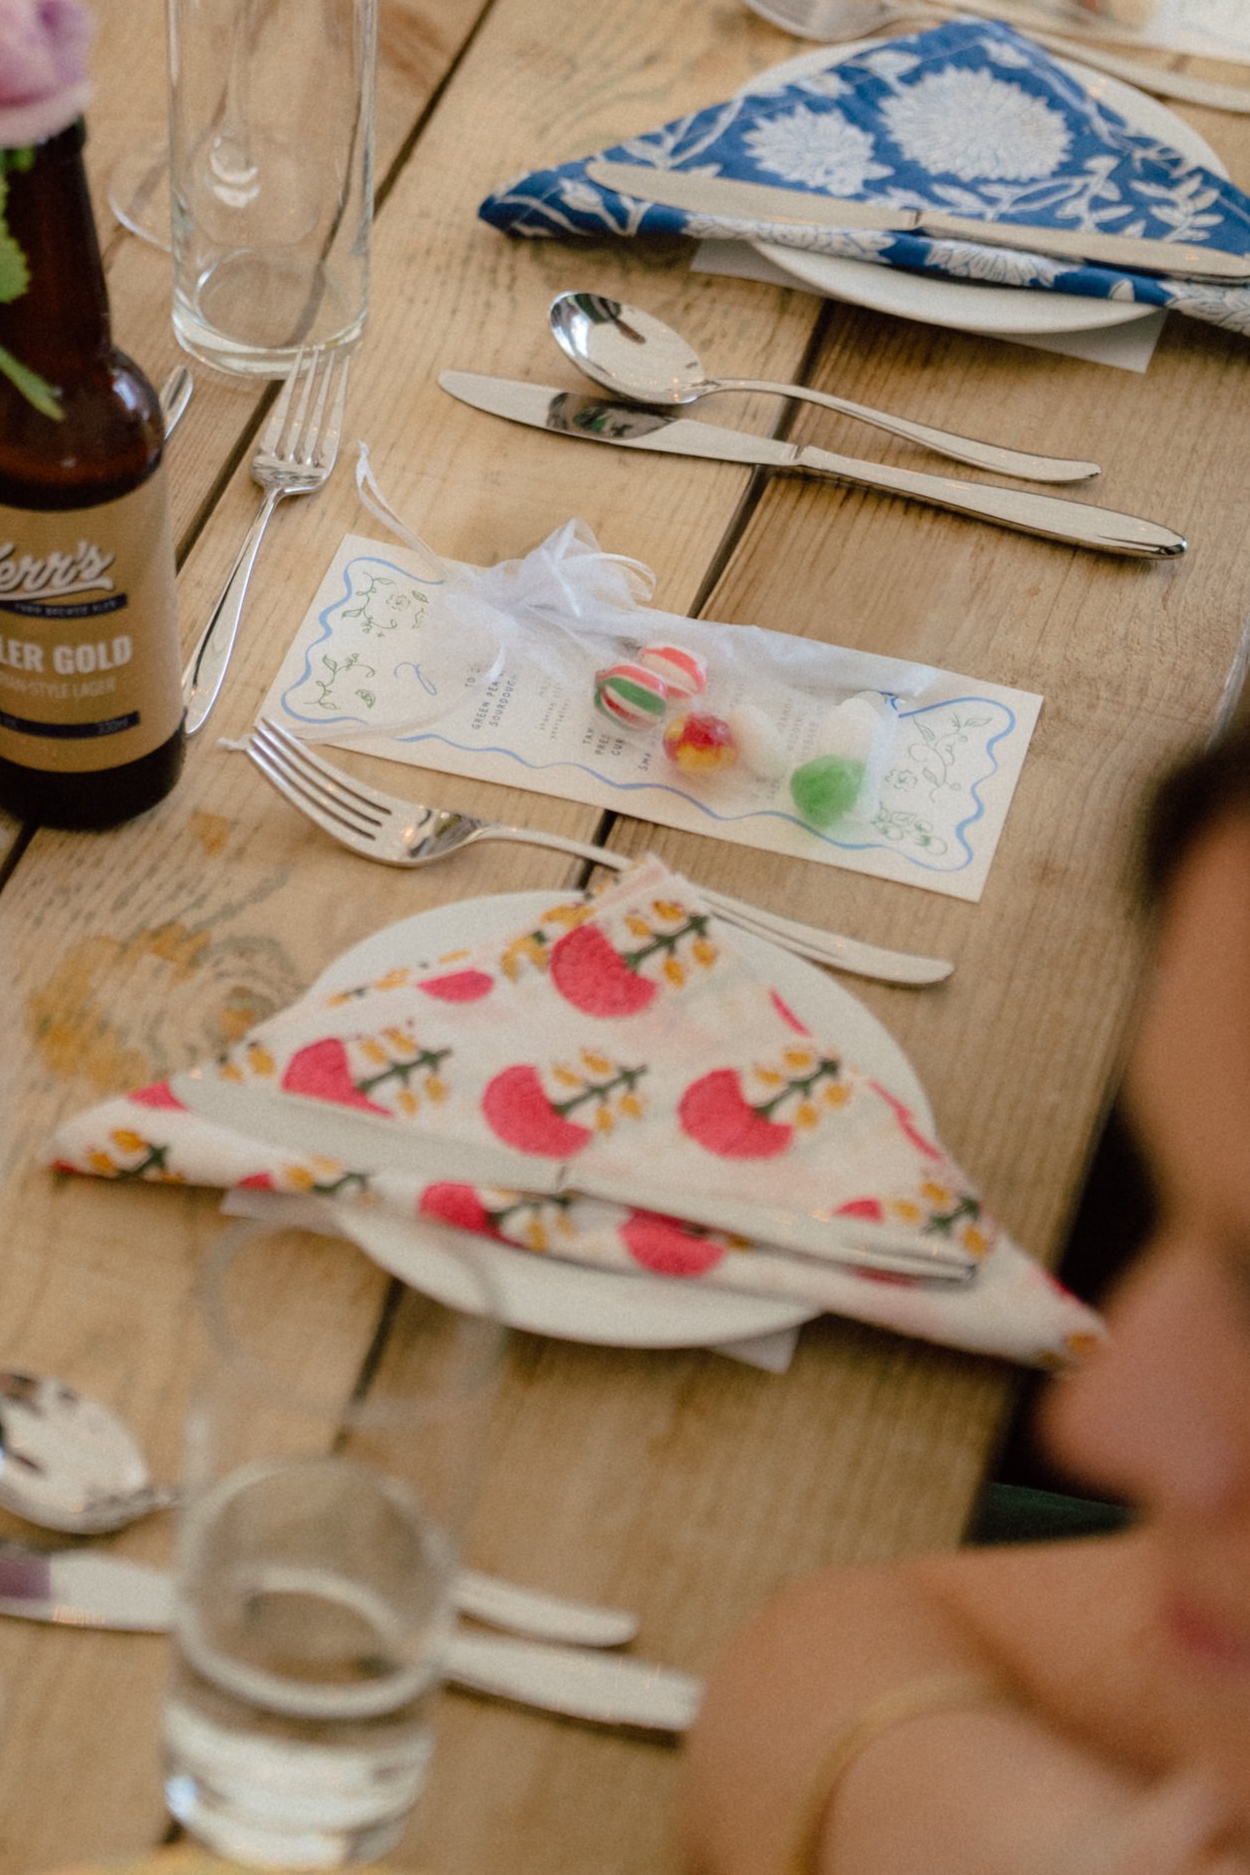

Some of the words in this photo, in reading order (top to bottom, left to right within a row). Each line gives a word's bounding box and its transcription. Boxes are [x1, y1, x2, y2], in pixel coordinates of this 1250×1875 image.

[53, 635, 134, 675] GOLD
[471, 701, 490, 730] GREEN
[486, 681, 501, 698] PEA
